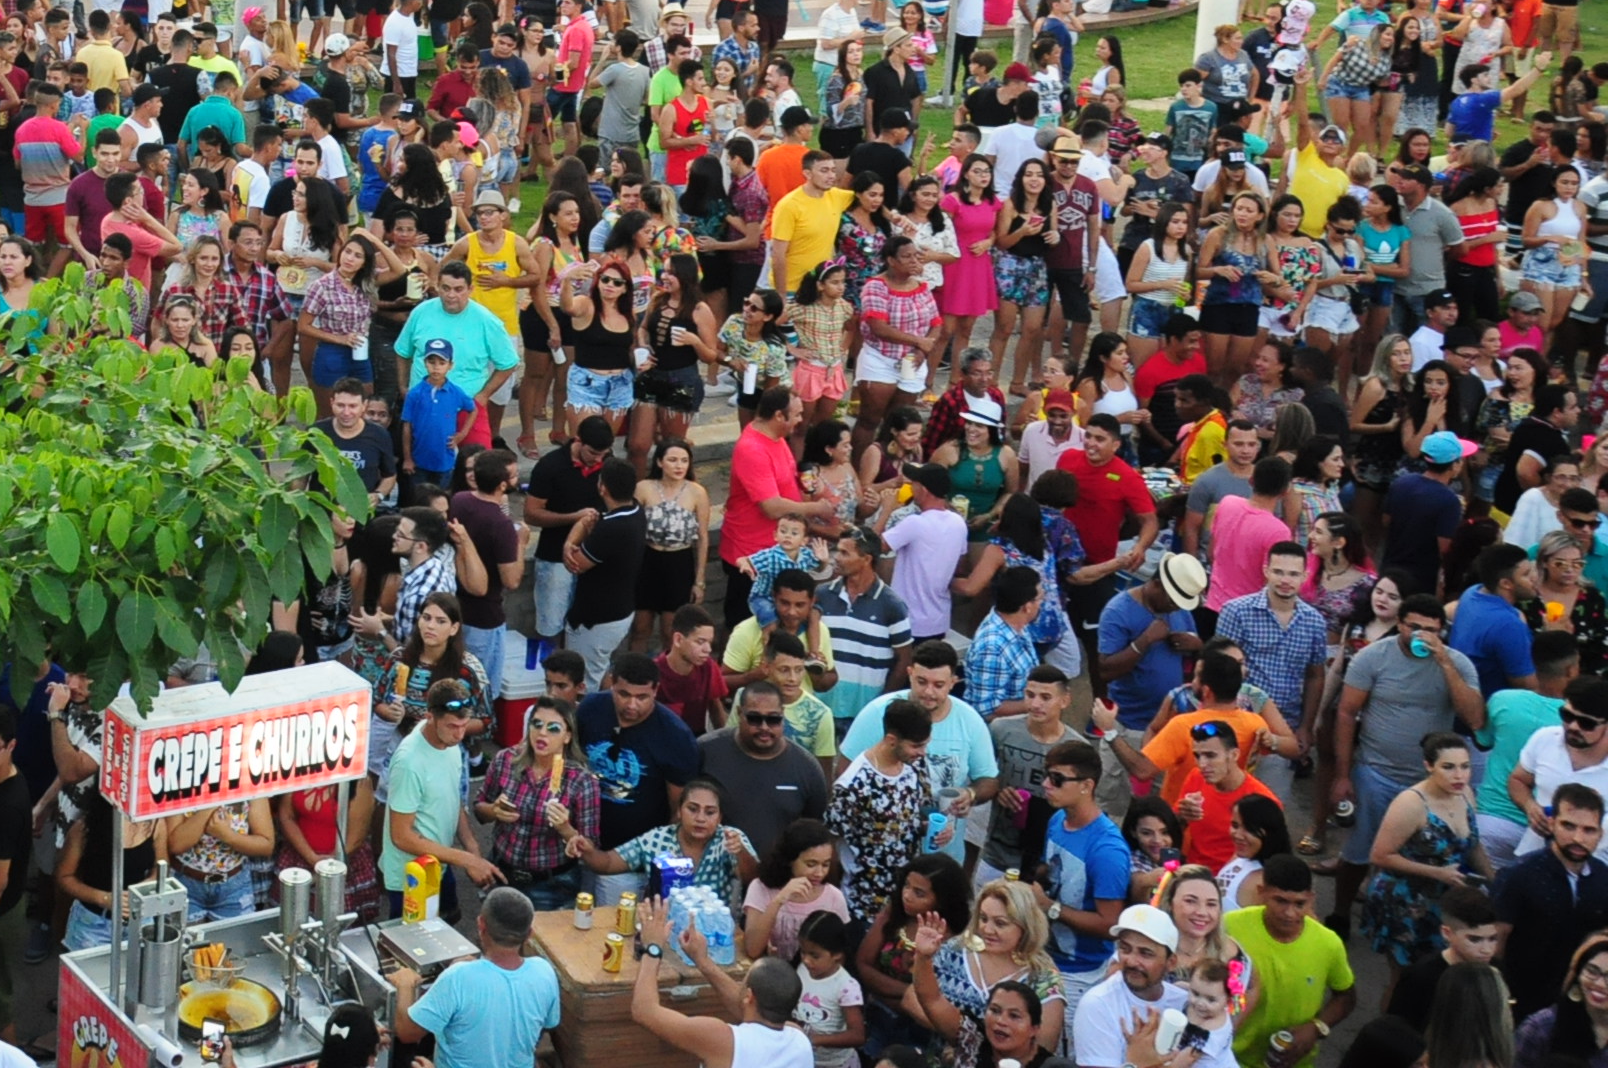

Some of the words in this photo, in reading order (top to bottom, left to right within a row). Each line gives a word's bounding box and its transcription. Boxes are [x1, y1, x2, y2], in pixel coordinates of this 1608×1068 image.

[148, 727, 223, 799] CREPE
[228, 722, 243, 783] E
[248, 701, 359, 779] CHURROS
[73, 1015, 119, 1063] CREPE
